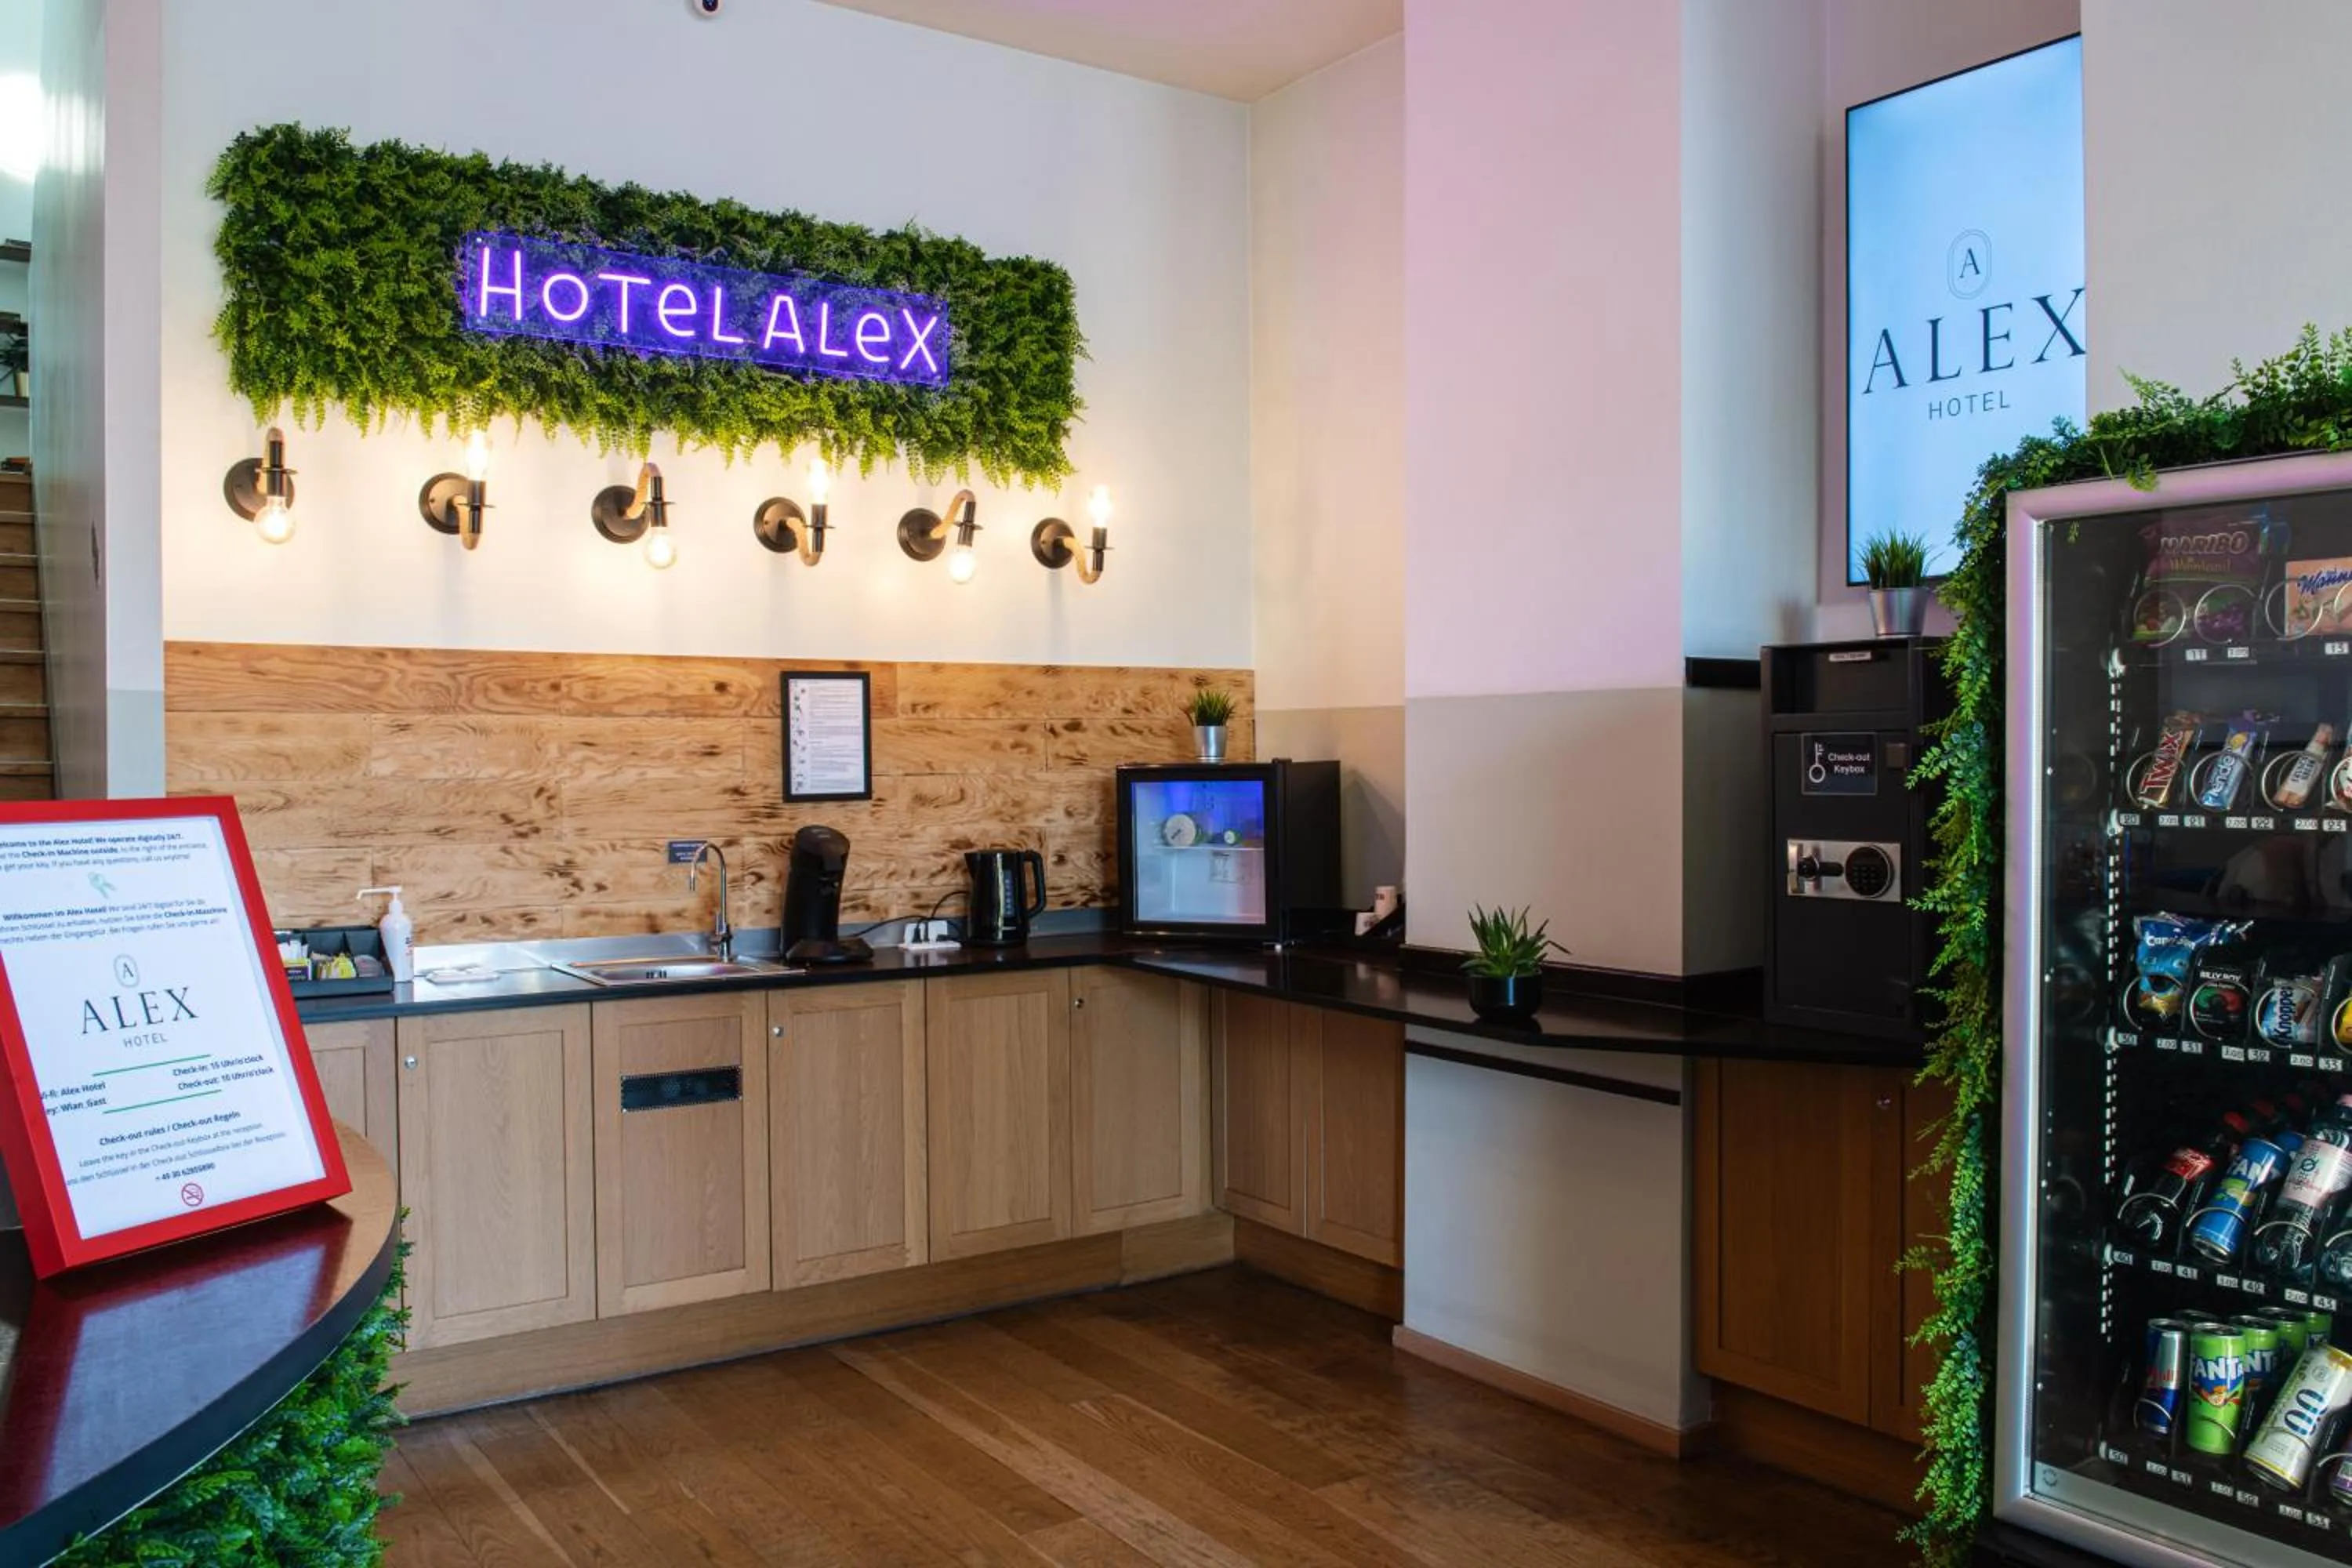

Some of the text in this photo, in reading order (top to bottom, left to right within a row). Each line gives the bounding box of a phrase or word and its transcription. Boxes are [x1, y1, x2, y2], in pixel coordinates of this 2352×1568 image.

[1959, 248, 1980, 278] A
[1862, 287, 2086, 395] ALEX
[1928, 390, 2011, 420] HOTEL
[1828, 752, 1870, 761] Check-out
[1834, 765, 1864, 775] Keybox
[123, 963, 134, 979] A
[82, 986, 199, 1034] ALEX
[122, 1033, 169, 1048] HOTEL
[61, 1086, 80, 1096] Alex
[82, 1080, 106, 1092] Hotel
[100, 1131, 143, 1145] Check-out
[144, 1127, 165, 1137] rules
[172, 1117, 212, 1131] Check-out
[214, 1111, 241, 1123] Regeln
